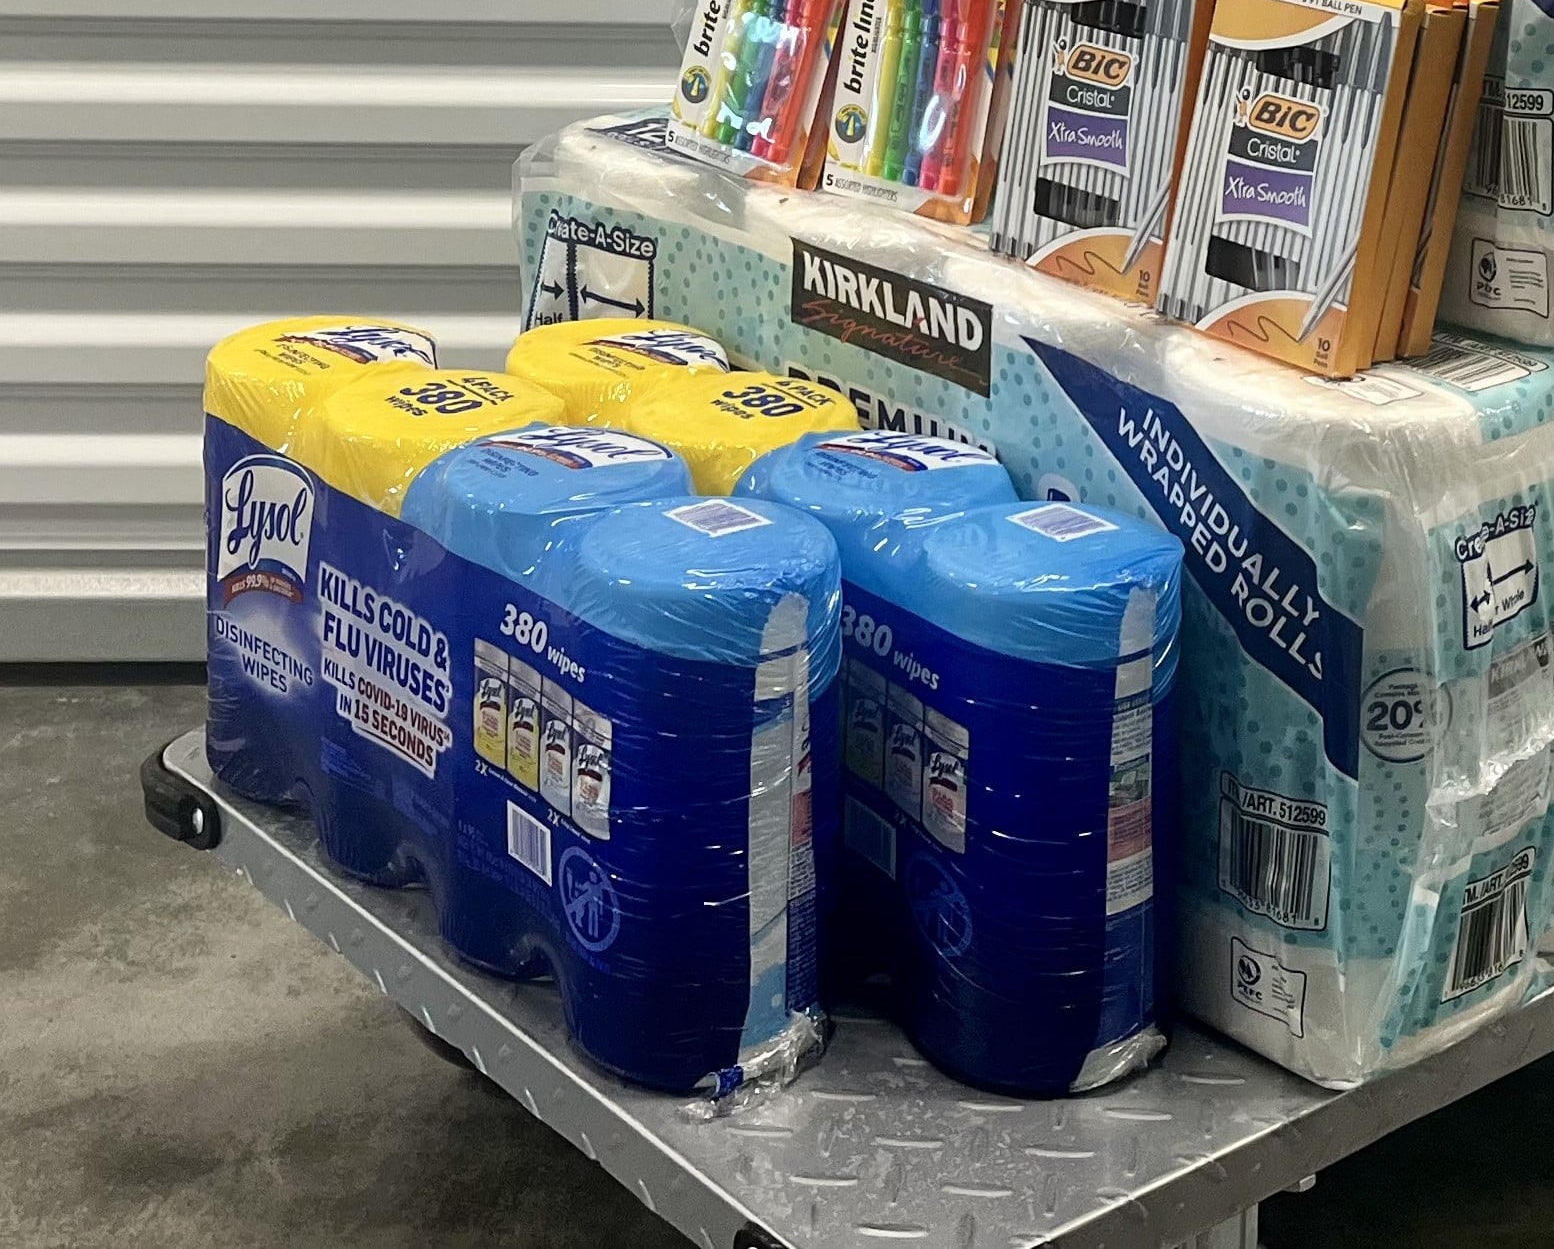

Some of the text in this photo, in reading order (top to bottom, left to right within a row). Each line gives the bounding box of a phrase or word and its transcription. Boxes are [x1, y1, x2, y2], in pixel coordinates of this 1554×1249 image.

[1344, 3, 1363, 16] PEN
[694, 0, 721, 58] brite
[843, 30, 869, 95] brite
[1071, 49, 1128, 81] BIC
[1066, 85, 1112, 108] Cristal
[1255, 100, 1316, 133] BIC
[667, 130, 675, 143] 5
[1247, 137, 1297, 163] Cristal
[826, 173, 834, 186] 5
[1139, 269, 1150, 282] 10
[803, 251, 984, 351] KIRKLAND
[1318, 337, 1330, 352] 10
[384, 395, 428, 416] wipes
[400, 382, 483, 414] 380
[471, 381, 514, 402] PACK
[722, 386, 804, 417] 380
[787, 386, 836, 406] PACK
[710, 399, 754, 419] wipes
[1119, 407, 1227, 574] WRAPPED
[226, 469, 307, 570] Lysol
[1143, 408, 1319, 627] INDIVIDUALLY
[320, 566, 447, 673] KILLS COLD &
[323, 610, 361, 659] FLU
[216, 615, 314, 687] DISINFECTING
[500, 603, 586, 684] 380 wipes
[842, 605, 940, 691] 380 wipes
[242, 652, 288, 694] WIPES
[324, 656, 356, 690] KILLS
[357, 676, 409, 722] COVID-19
[340, 693, 434, 767] IN 15 SECONDS
[474, 758, 489, 776] 2X
[546, 808, 560, 828] 2X
[1279, 800, 1326, 826] 512599
